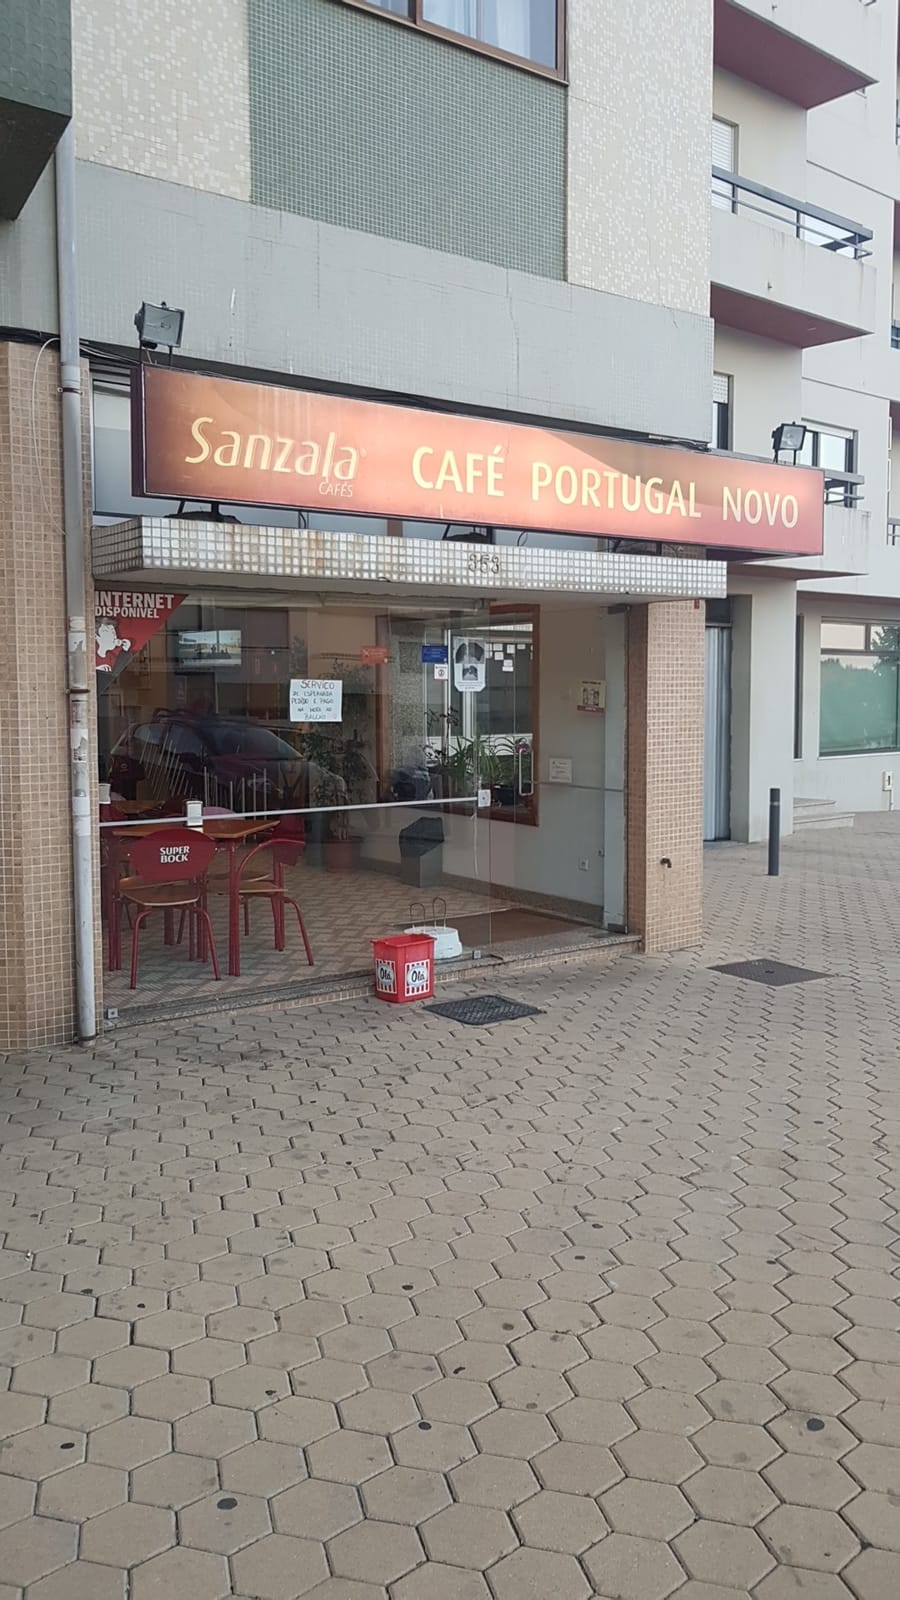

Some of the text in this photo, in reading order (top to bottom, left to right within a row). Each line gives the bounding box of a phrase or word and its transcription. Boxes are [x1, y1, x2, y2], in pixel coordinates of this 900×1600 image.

[185, 416, 799, 529] Sanzala CAFÉ PORTUGAL NOVO
[319, 481, 353, 498] CAFÉS
[468, 553, 499, 574] 353
[94, 591, 174, 609] INTERNET
[160, 845, 190, 855] SUPER
[160, 854, 188, 863] BOCK
